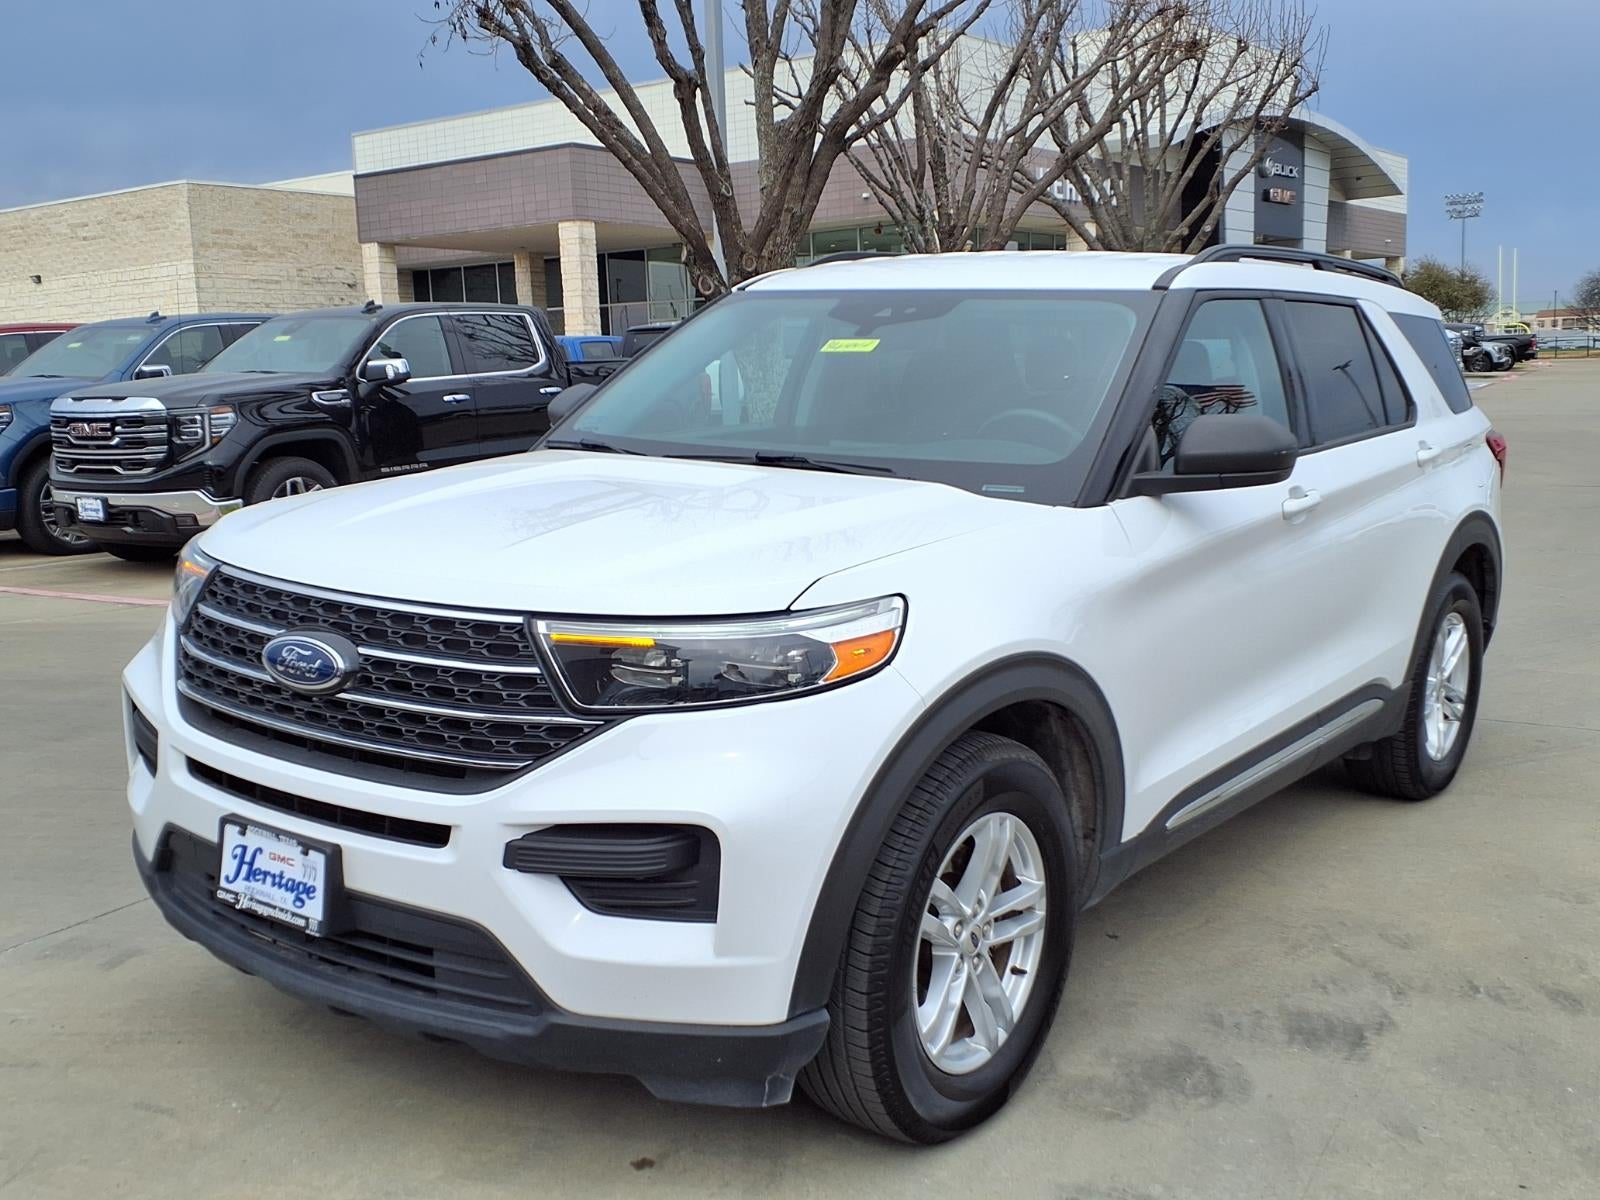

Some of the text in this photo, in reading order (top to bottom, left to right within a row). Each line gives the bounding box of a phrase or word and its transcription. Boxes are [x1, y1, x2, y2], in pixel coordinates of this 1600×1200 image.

[1274, 162, 1299, 178] BUICK
[69, 422, 111, 437] GMC
[277, 645, 322, 678] Ford
[268, 851, 296, 867] GMC
[225, 844, 316, 908] Heritage
